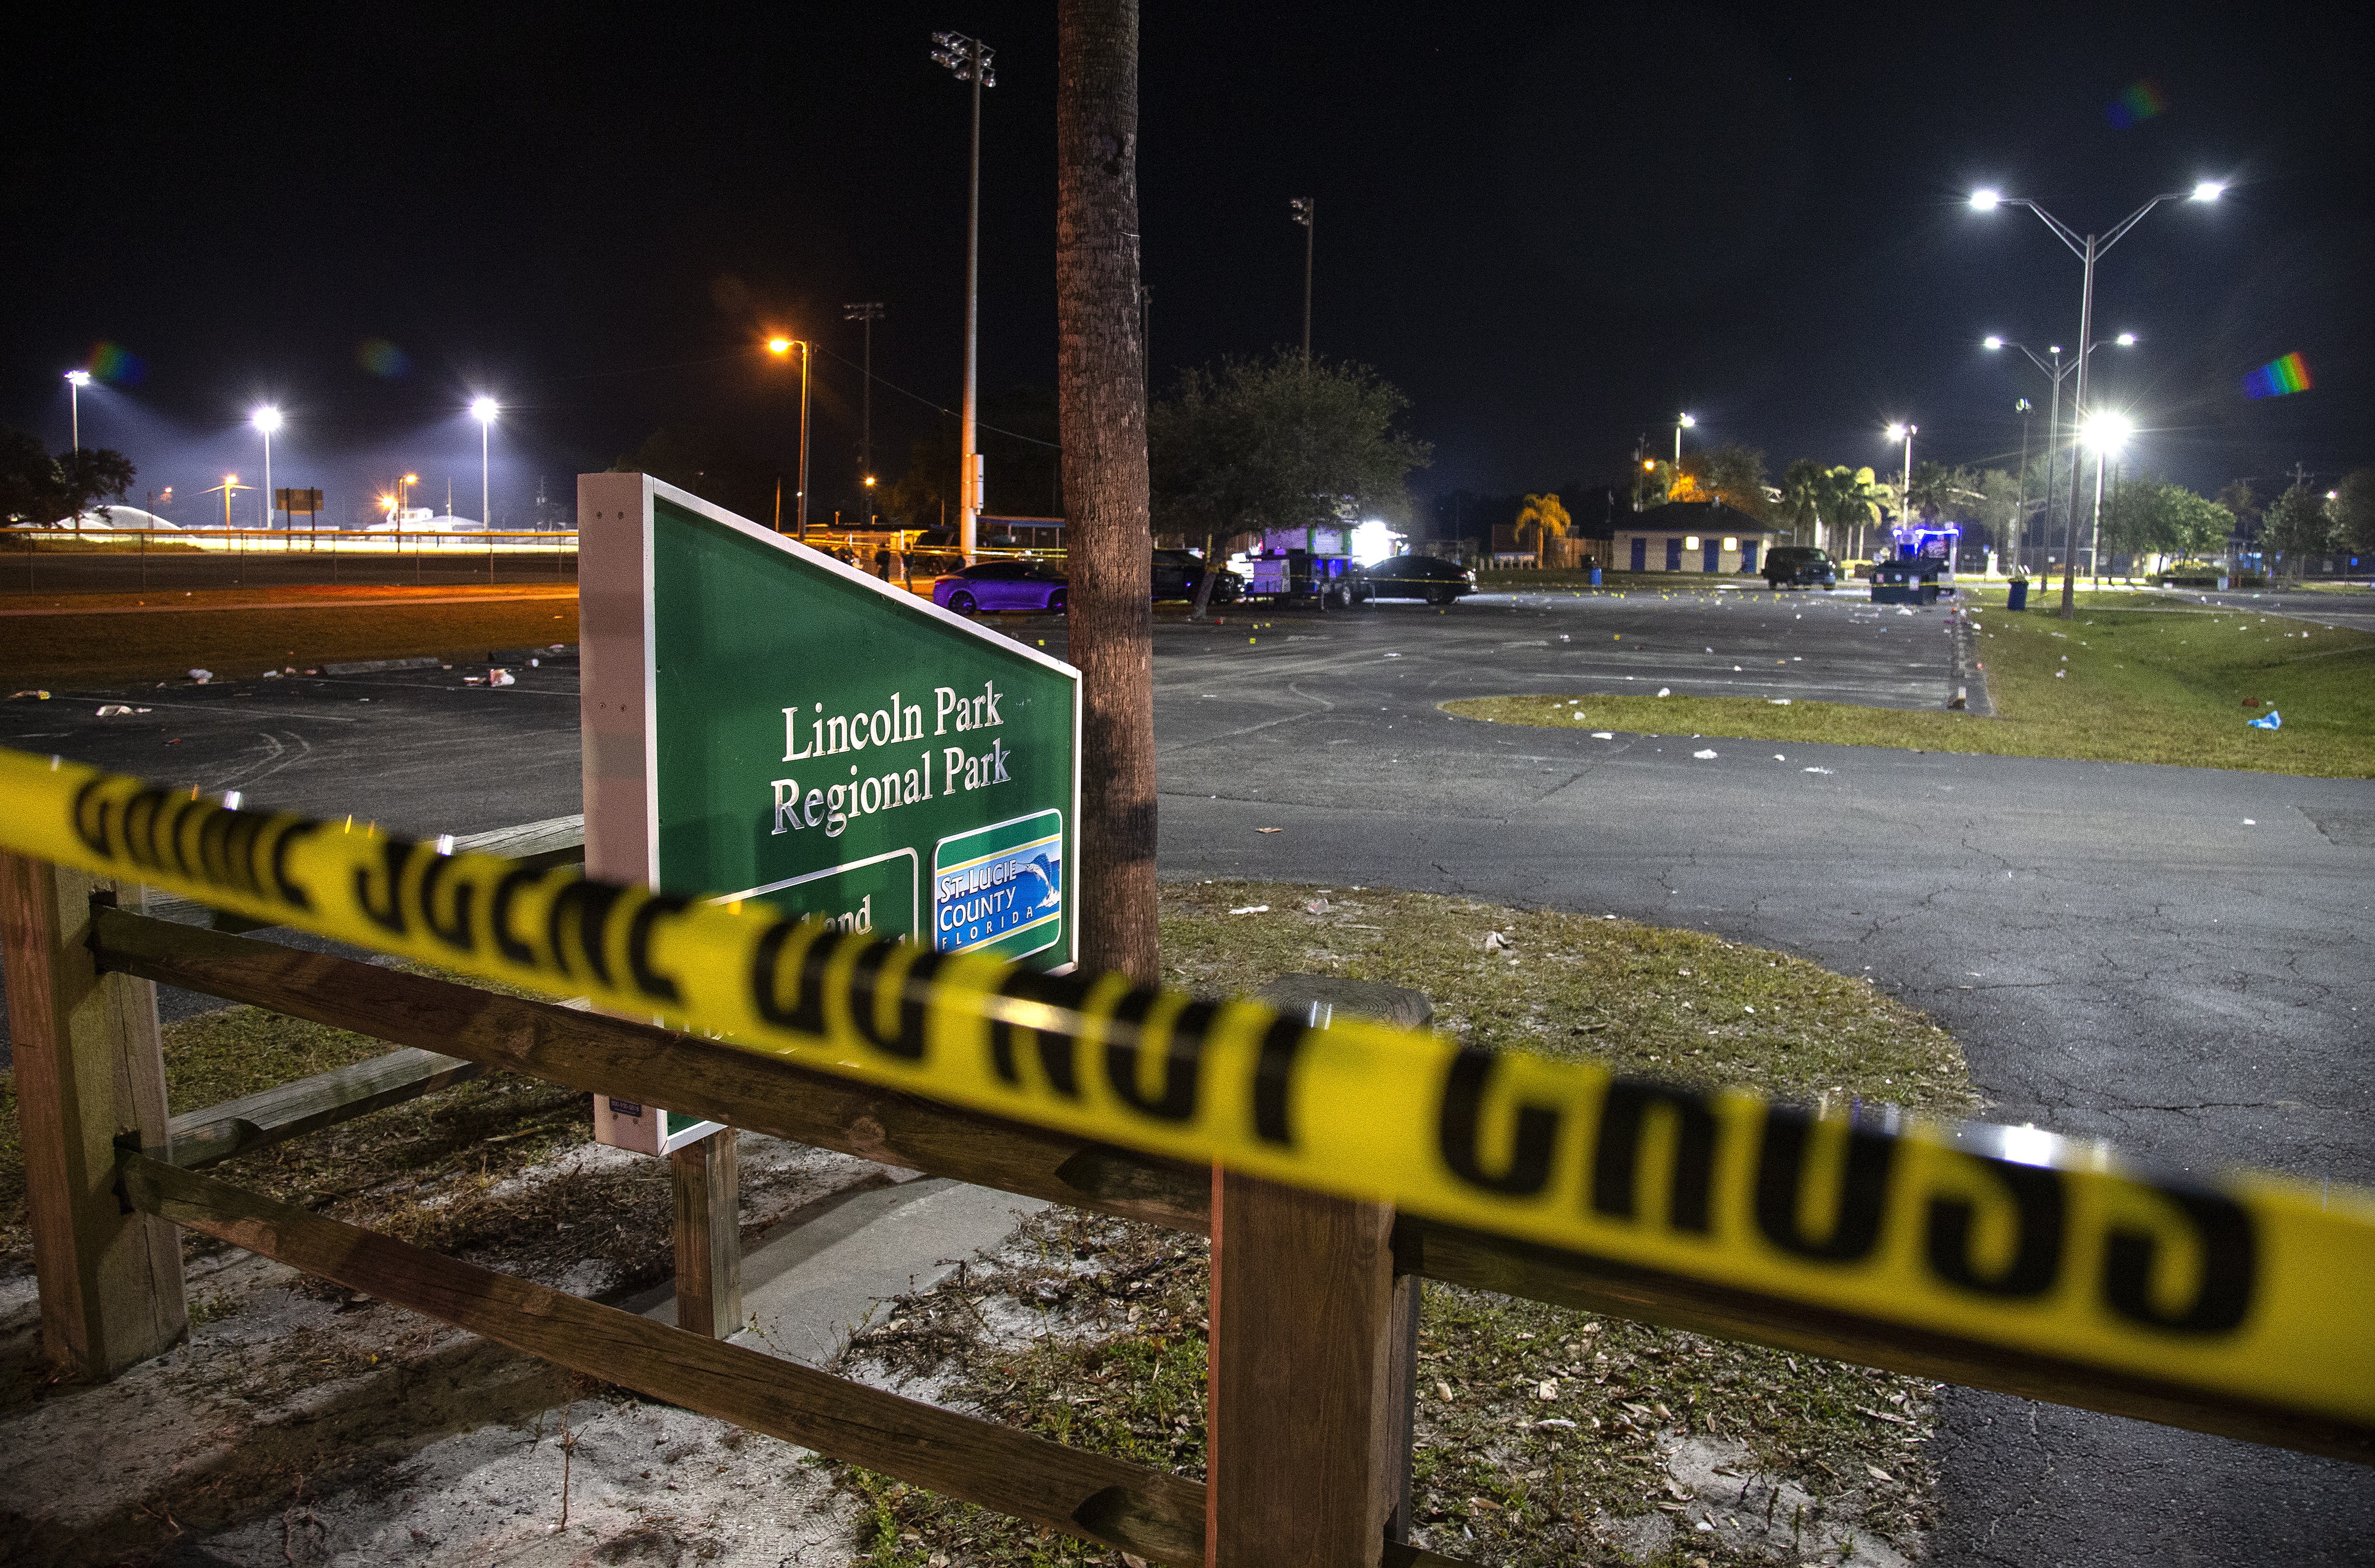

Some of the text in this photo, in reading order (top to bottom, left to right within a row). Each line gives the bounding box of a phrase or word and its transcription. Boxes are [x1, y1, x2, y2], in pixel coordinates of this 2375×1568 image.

[781, 679, 1004, 762] Lincoln Park
[770, 737, 1012, 837] Regional Park
[940, 859, 1017, 903] ST. LUCIE
[939, 886, 1016, 932] COUNTY
[942, 906, 1033, 950] FLORIDA
